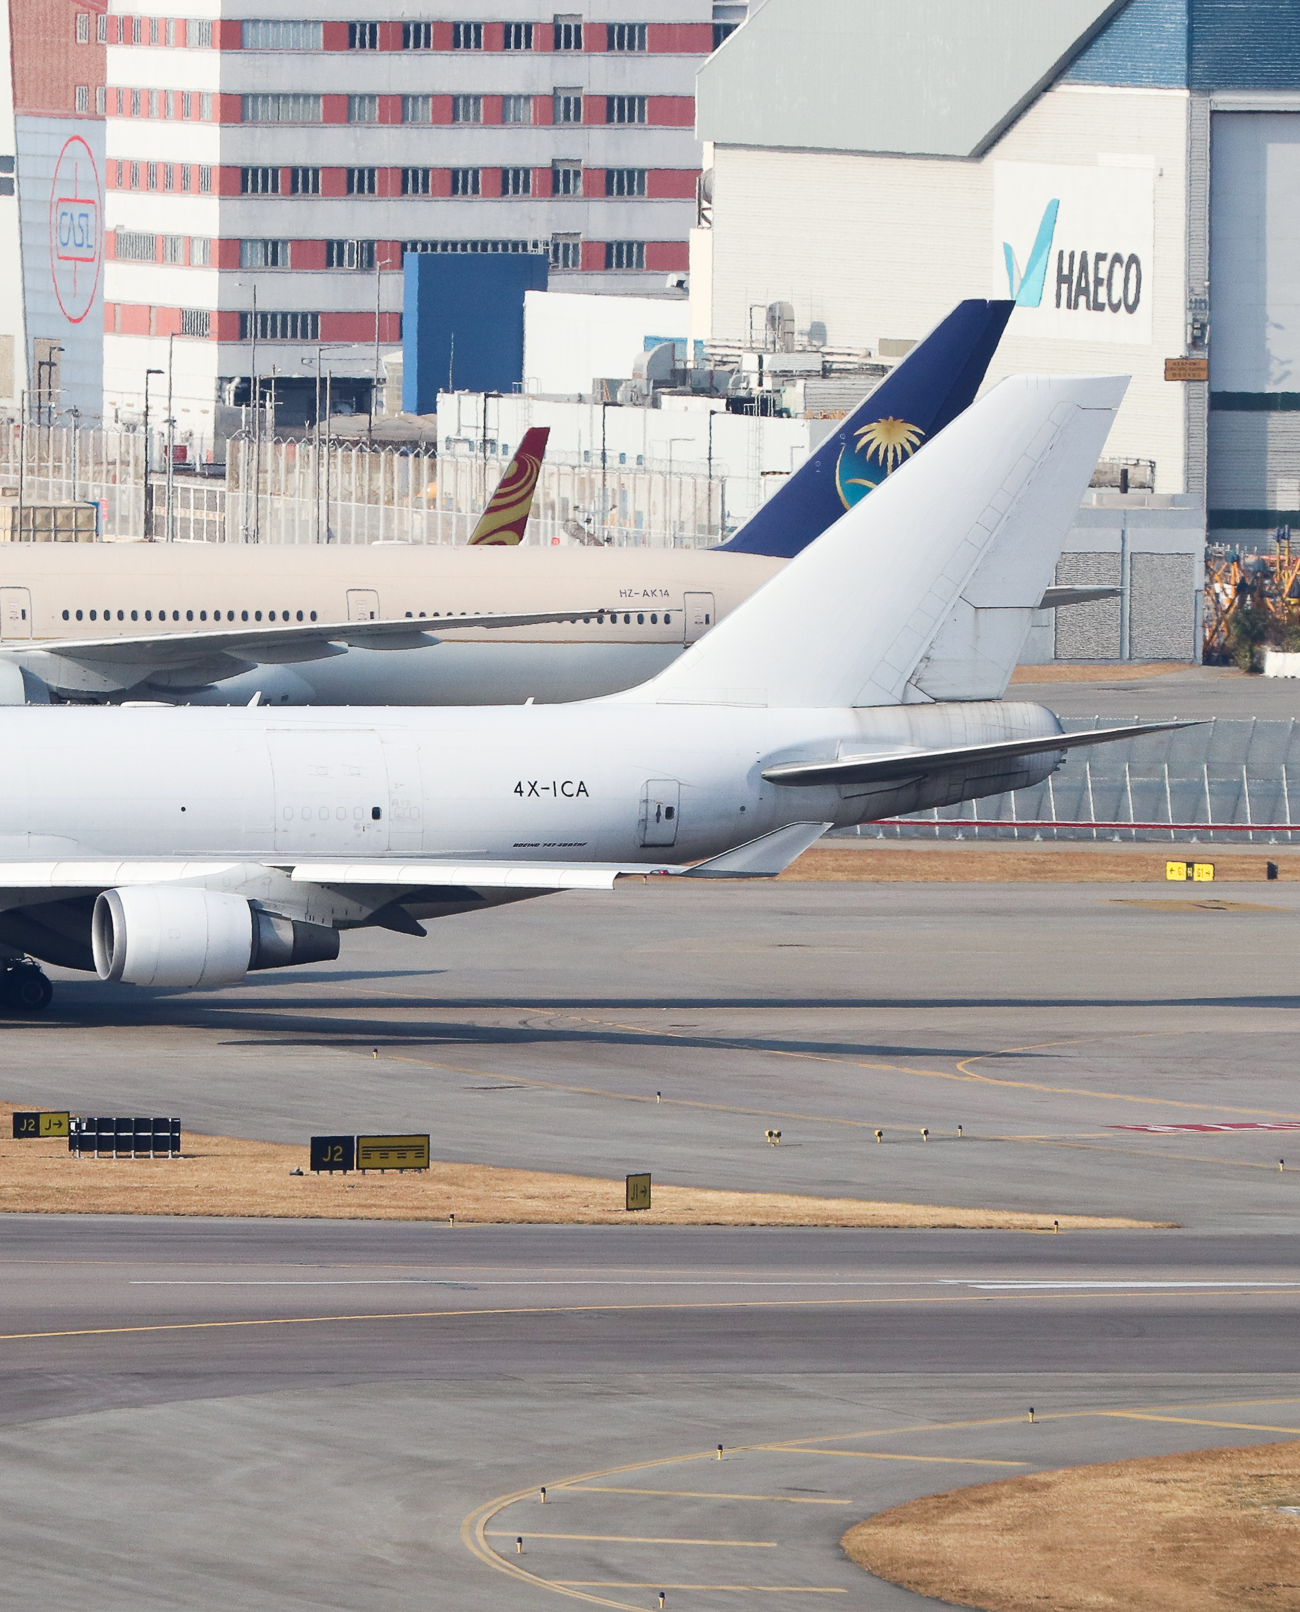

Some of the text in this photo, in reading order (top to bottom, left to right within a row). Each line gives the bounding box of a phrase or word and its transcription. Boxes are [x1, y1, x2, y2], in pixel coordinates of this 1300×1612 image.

[1055, 249, 1142, 315] HAECO
[619, 588, 670, 598] HZ-AK14
[513, 780, 590, 798] 4X-ICA
[20, 1118, 52, 1131] J2 J
[322, 1145, 344, 1162] J2
